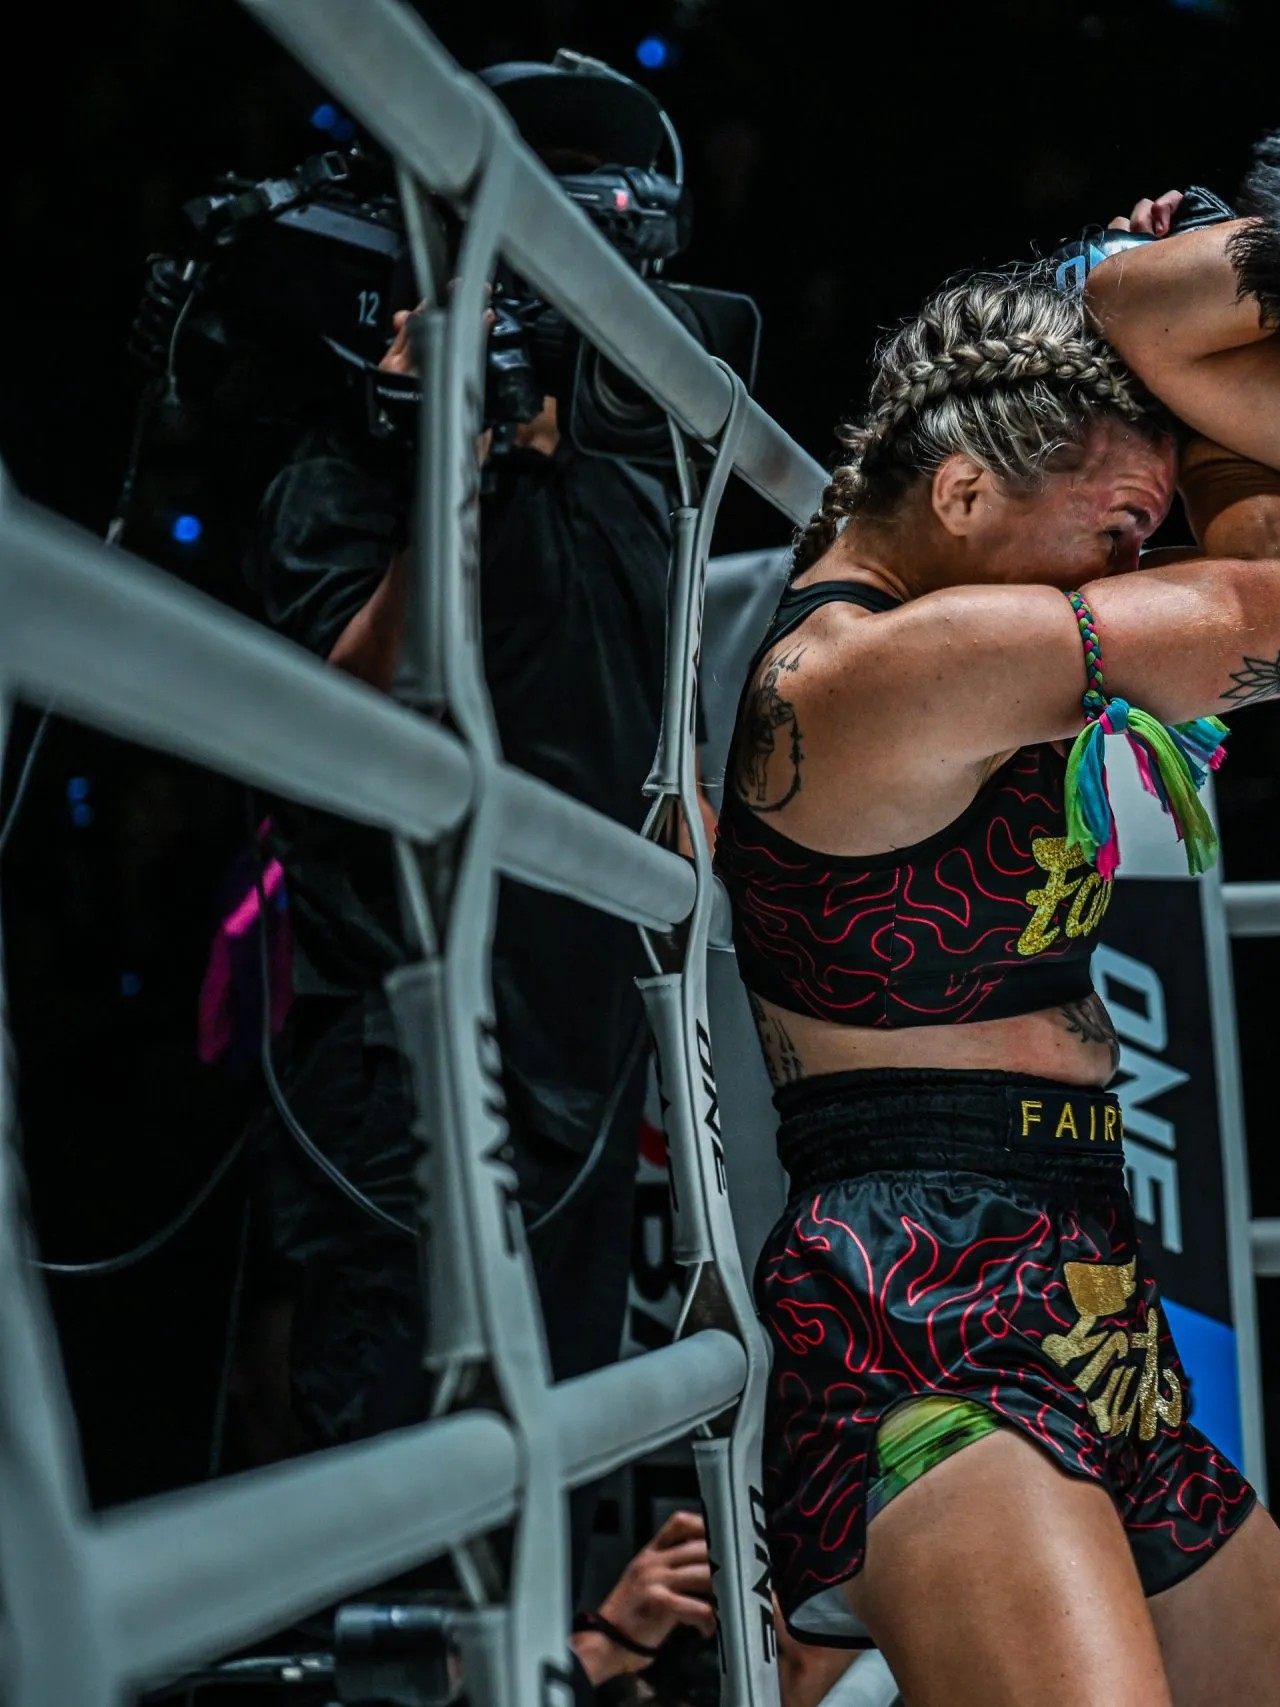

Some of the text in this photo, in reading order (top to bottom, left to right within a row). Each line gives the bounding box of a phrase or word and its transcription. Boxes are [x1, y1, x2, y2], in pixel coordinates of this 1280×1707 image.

[357, 288, 381, 328] 12
[696, 1018, 728, 1197] ONE
[1021, 1100, 1123, 1141] FAIR
[1089, 942, 1191, 1255] ONE
[748, 1484, 778, 1665] ONE
